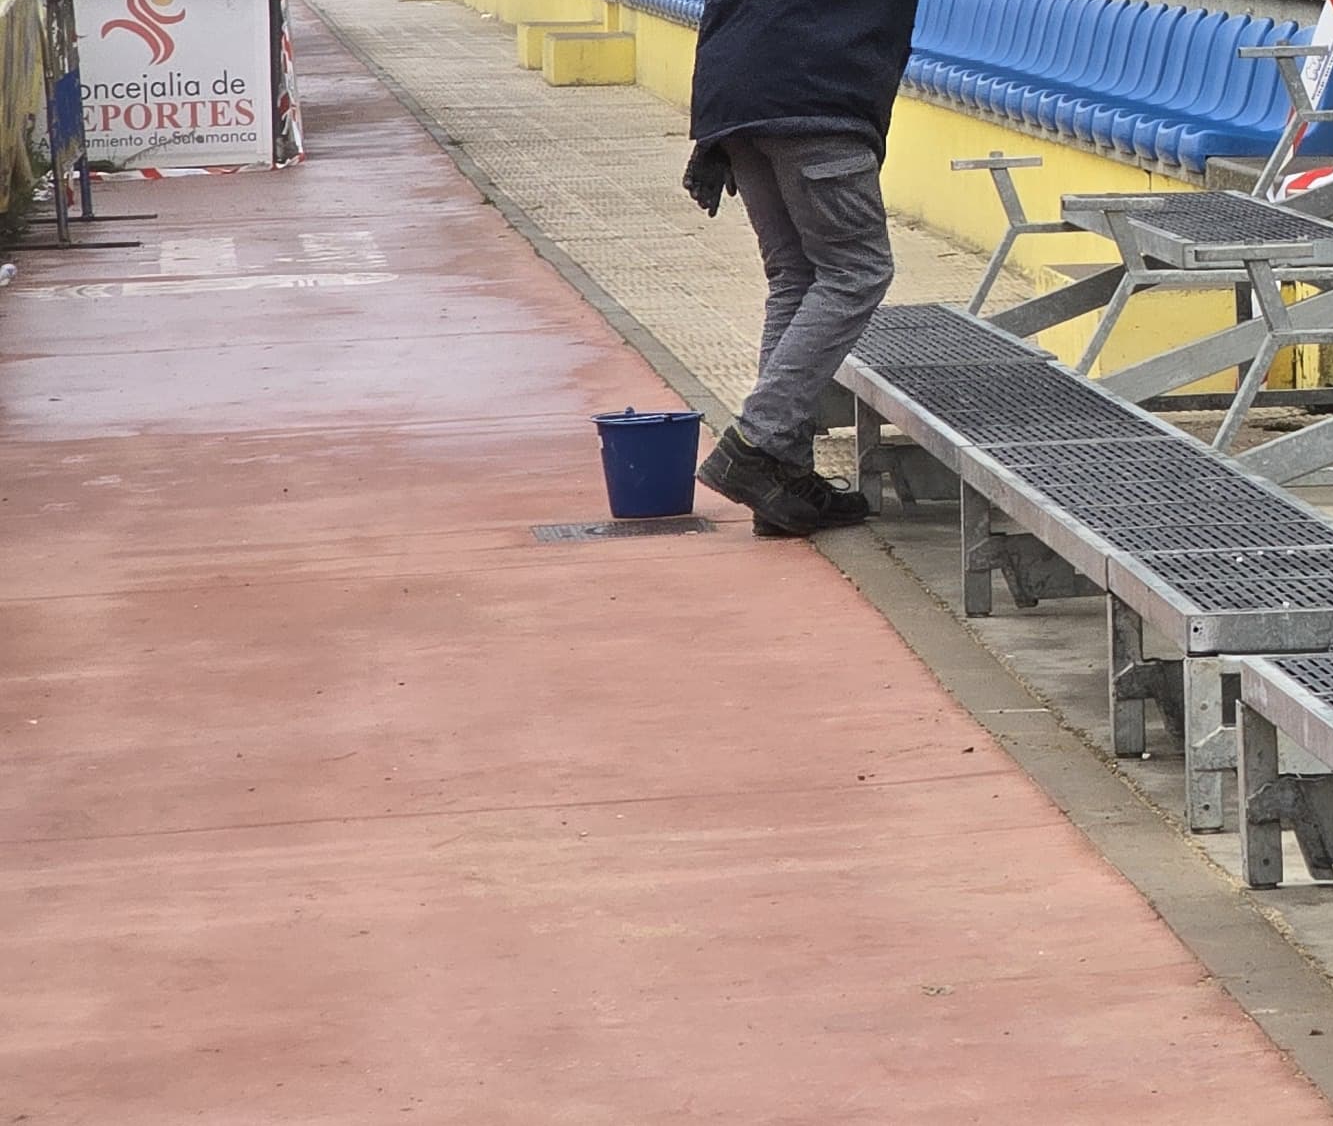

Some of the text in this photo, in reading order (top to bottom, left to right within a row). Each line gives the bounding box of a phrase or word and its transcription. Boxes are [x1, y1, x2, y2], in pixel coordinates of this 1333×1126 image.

[79, 70, 246, 104] oncejalia de
[80, 98, 256, 133] EPORTES
[37, 130, 257, 150] Aamiento de Salamanca
